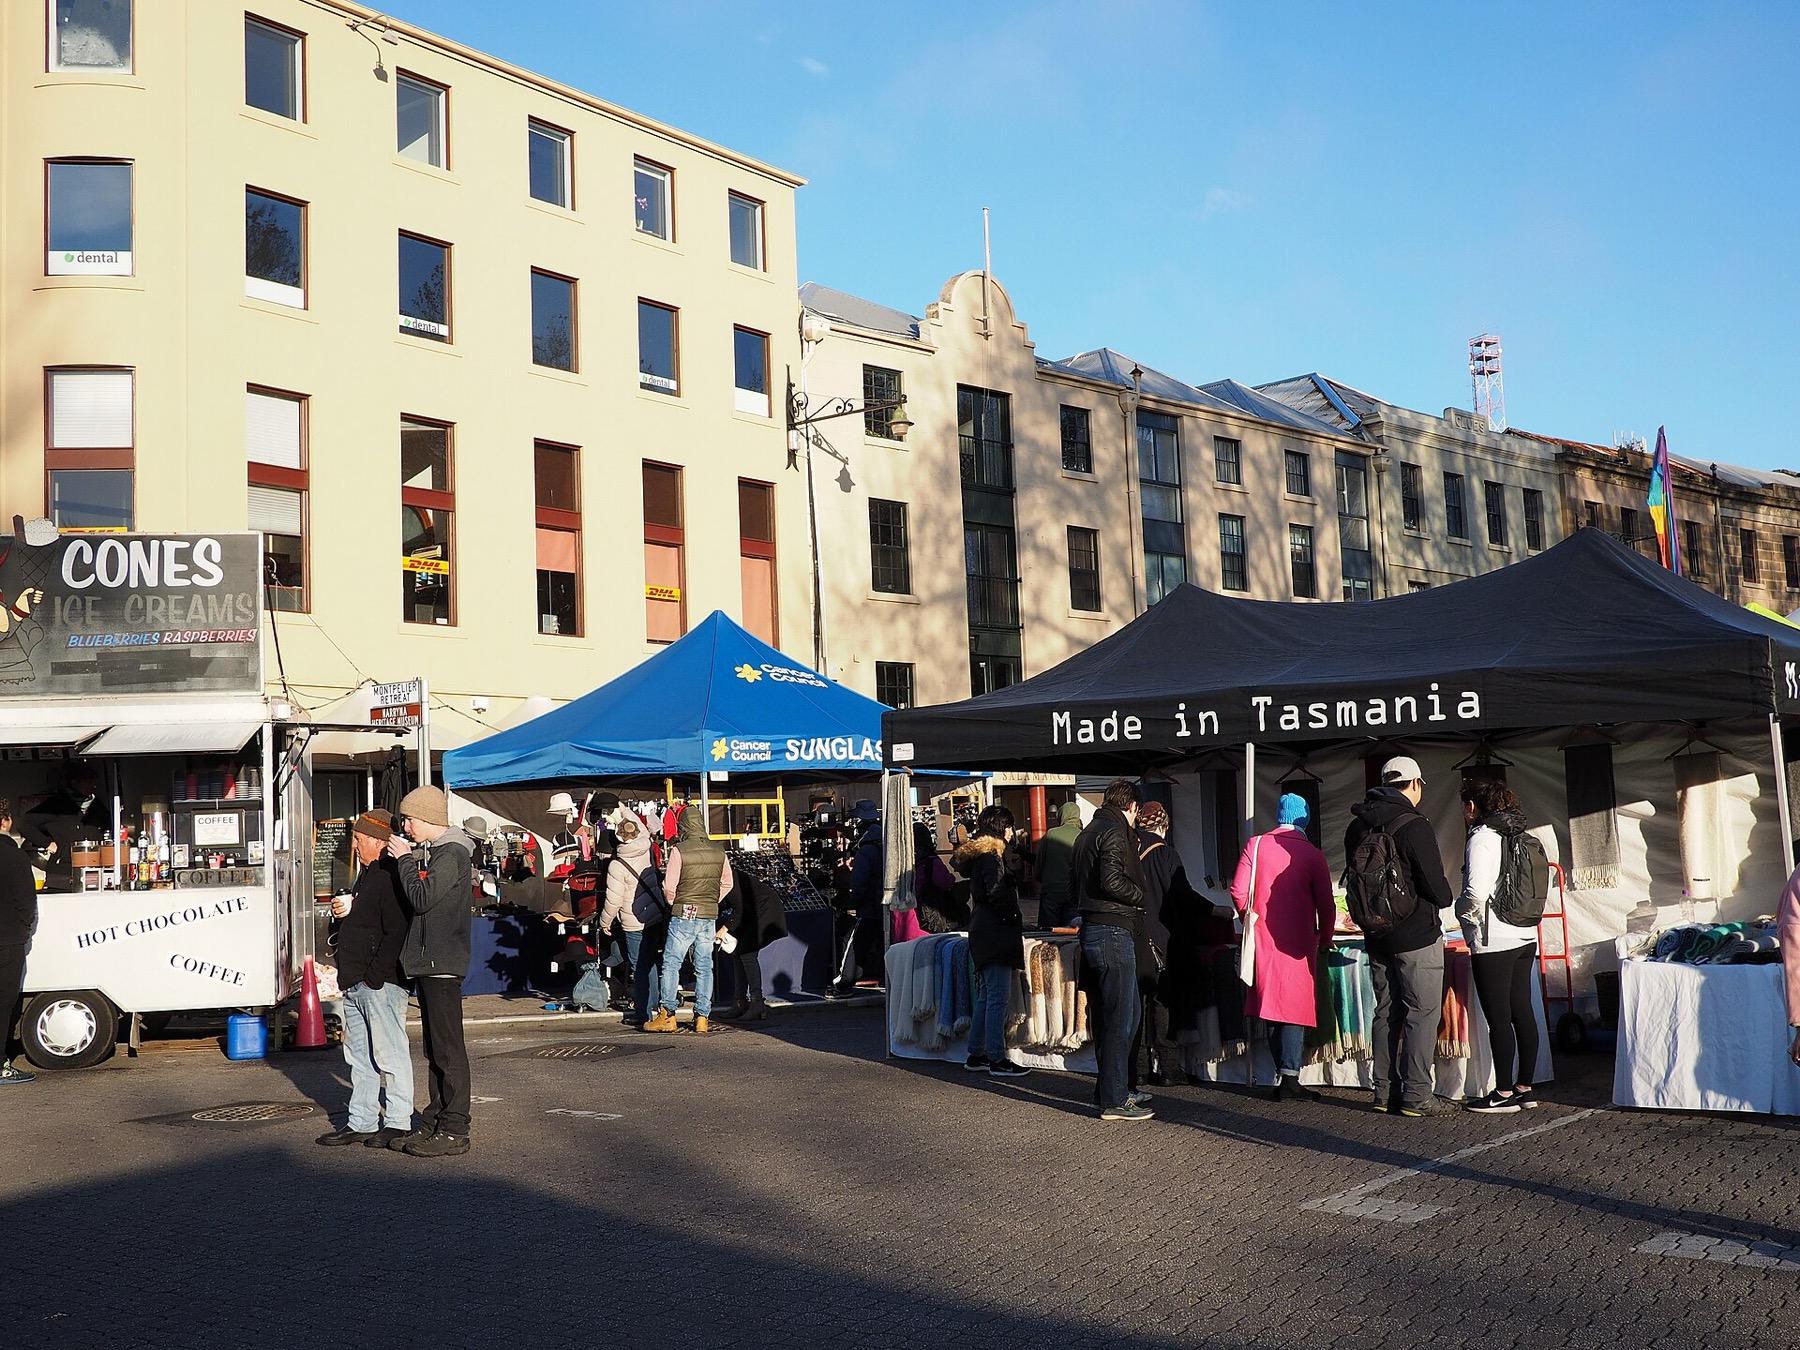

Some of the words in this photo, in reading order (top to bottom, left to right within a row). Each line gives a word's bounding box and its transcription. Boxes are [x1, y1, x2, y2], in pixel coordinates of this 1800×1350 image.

[77, 251, 118, 263] dental
[412, 318, 440, 334] dental
[648, 376, 671, 388] dental
[61, 538, 224, 589] CONES
[408, 559, 442, 572] DHL
[648, 587, 675, 598] DHL
[54, 595, 102, 626] ICE
[124, 592, 254, 624] CREAMS
[68, 632, 160, 648] BLUEBERRIES
[162, 628, 258, 645] RASPBERRIES
[760, 664, 816, 680] Cancer
[769, 672, 829, 689] Council
[374, 683, 416, 695] MONTPELIER
[380, 692, 410, 703] RETREAT
[1052, 710, 1142, 745] Made
[1175, 703, 1219, 737] in
[1251, 683, 1480, 732] Tasmania
[730, 739, 771, 751] Cancer
[731, 750, 772, 761] Council
[198, 816, 234, 825] COFFEE
[177, 870, 254, 885] COFFEE
[77, 926, 119, 948] HOT
[125, 896, 249, 937] CHOCOLATE
[170, 953, 246, 987] COFFEE
